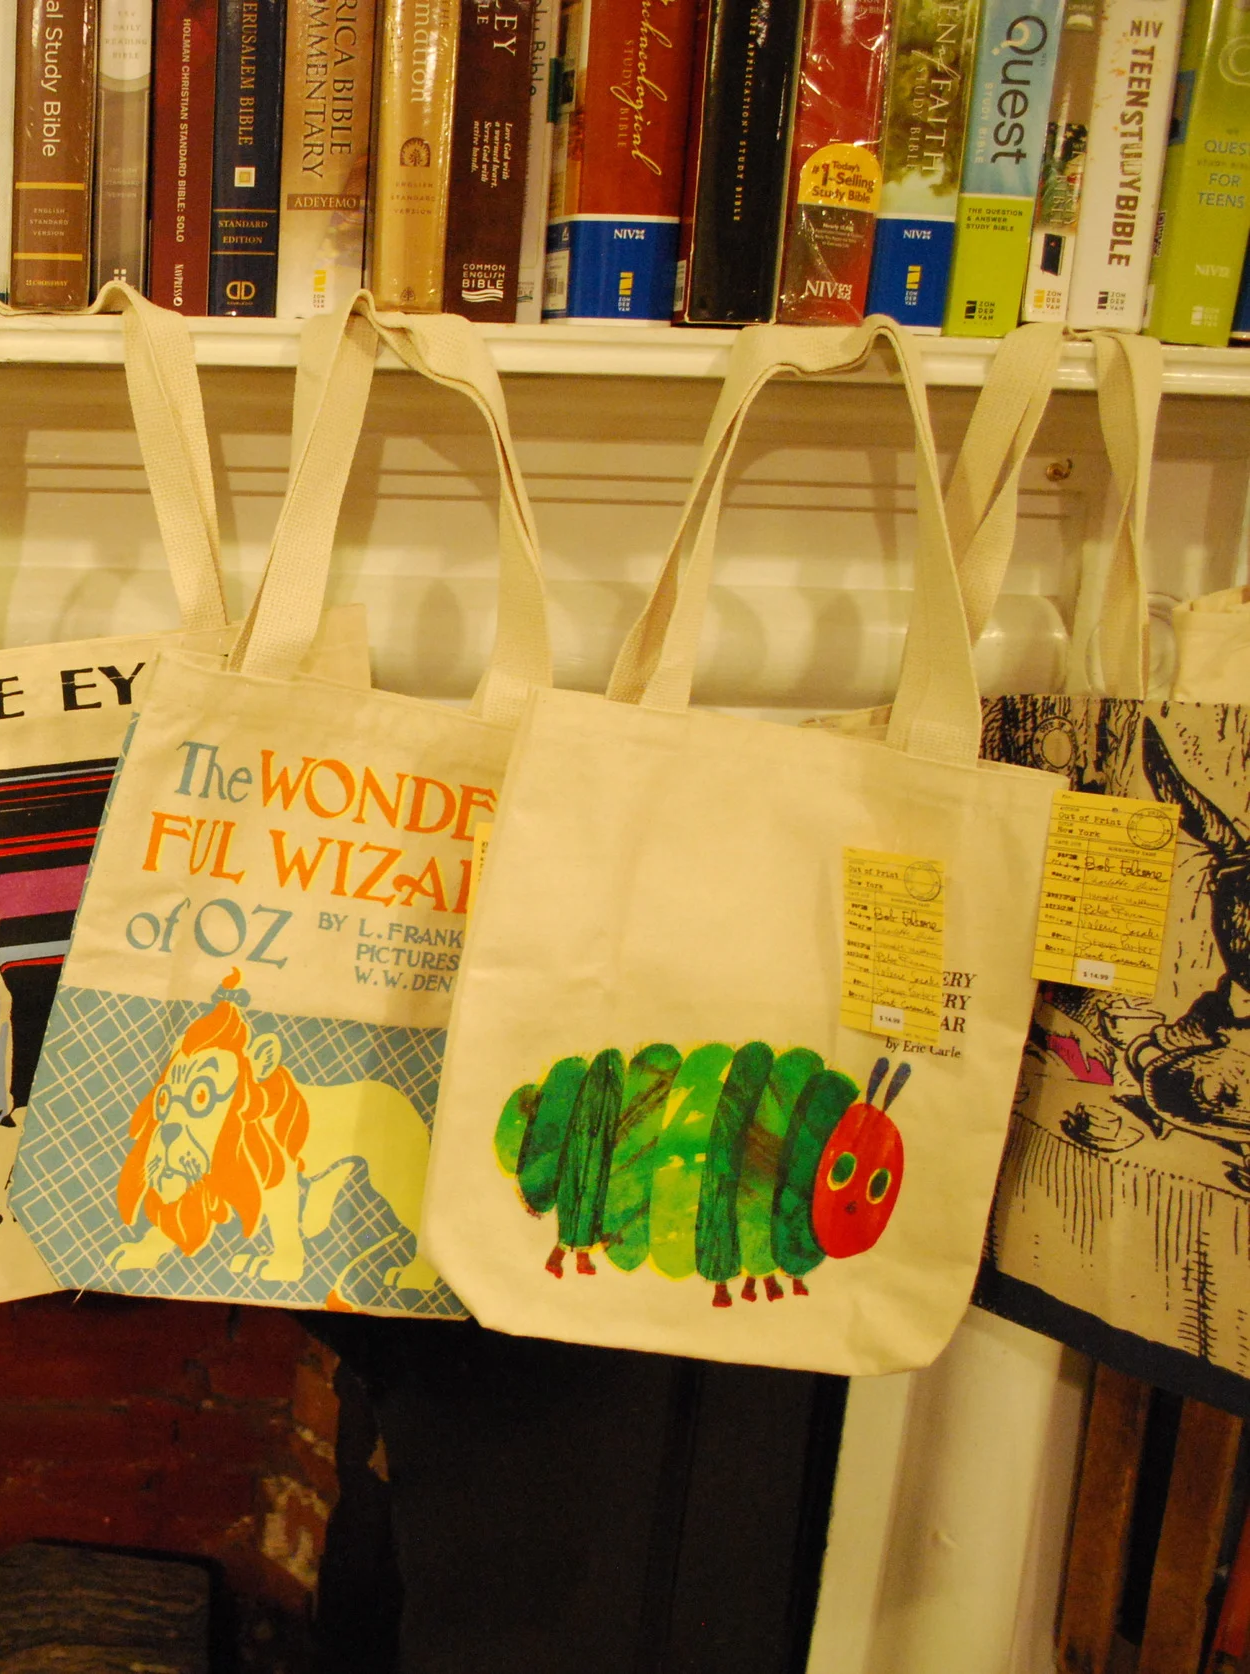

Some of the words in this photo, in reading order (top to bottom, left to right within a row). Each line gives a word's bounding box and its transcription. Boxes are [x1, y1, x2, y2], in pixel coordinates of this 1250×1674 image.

[46, 0, 63, 20] al
[1130, 20, 1164, 37] NIV
[181, 18, 191, 63] HOLMAN
[41, 26, 63, 93] Study
[621, 39, 632, 88] STUDY
[180, 65, 190, 120] CHRISTIAN
[912, 66, 927, 119] STUDY
[991, 14, 1048, 166] Quest
[981, 82, 994, 122] STUDY
[238, 96, 255, 146] BIBLE
[329, 78, 354, 155] BIBLE
[922, 78, 953, 173] FAITH
[42, 101, 62, 157] Bible
[482, 121, 492, 143] Serve
[502, 121, 513, 141] Love
[616, 107, 628, 149] BIBLE
[177, 123, 189, 178] STANDARD
[481, 145, 491, 162] God
[492, 129, 502, 163] warmed
[502, 143, 512, 159] God
[974, 129, 988, 164] BIBLE
[737, 140, 746, 179] STUDY
[832, 160, 860, 172] Today's
[479, 163, 490, 183] with
[501, 161, 511, 180] with
[1209, 173, 1241, 187] FOR
[176, 180, 187, 213] BIBLE:
[293, 197, 357, 209] ADEYEMO
[732, 186, 741, 221] BIBLE
[812, 186, 845, 202] Study
[847, 190, 871, 204] Bible
[1198, 192, 1245, 208] TEENS
[968, 207, 983, 215] THE
[985, 208, 1023, 217] QUESTION
[175, 215, 185, 243] SOLO
[218, 219, 268, 229] STANDARD
[965, 223, 991, 231] STUDY
[222, 235, 263, 244] EDITION
[462, 263, 506, 271] COMMON
[462, 271, 506, 279] ENGLISH
[461, 279, 505, 290] BIBLE
[173, 740, 253, 804] The
[1057, 811, 1077, 822] Out
[1079, 814, 1090, 823] of
[1094, 816, 1123, 827] Print
[1078, 829, 1100, 838] York
[141, 810, 246, 885] FUL
[1085, 856, 1117, 872] Bob
[125, 896, 192, 954] of
[193, 898, 294, 970] OZ
[317, 911, 349, 933] BY
[355, 942, 461, 972] PICTURES
[1090, 972, 1109, 981] 14.99
[885, 1037, 900, 1053] by
[903, 1041, 926, 1055] Eric
